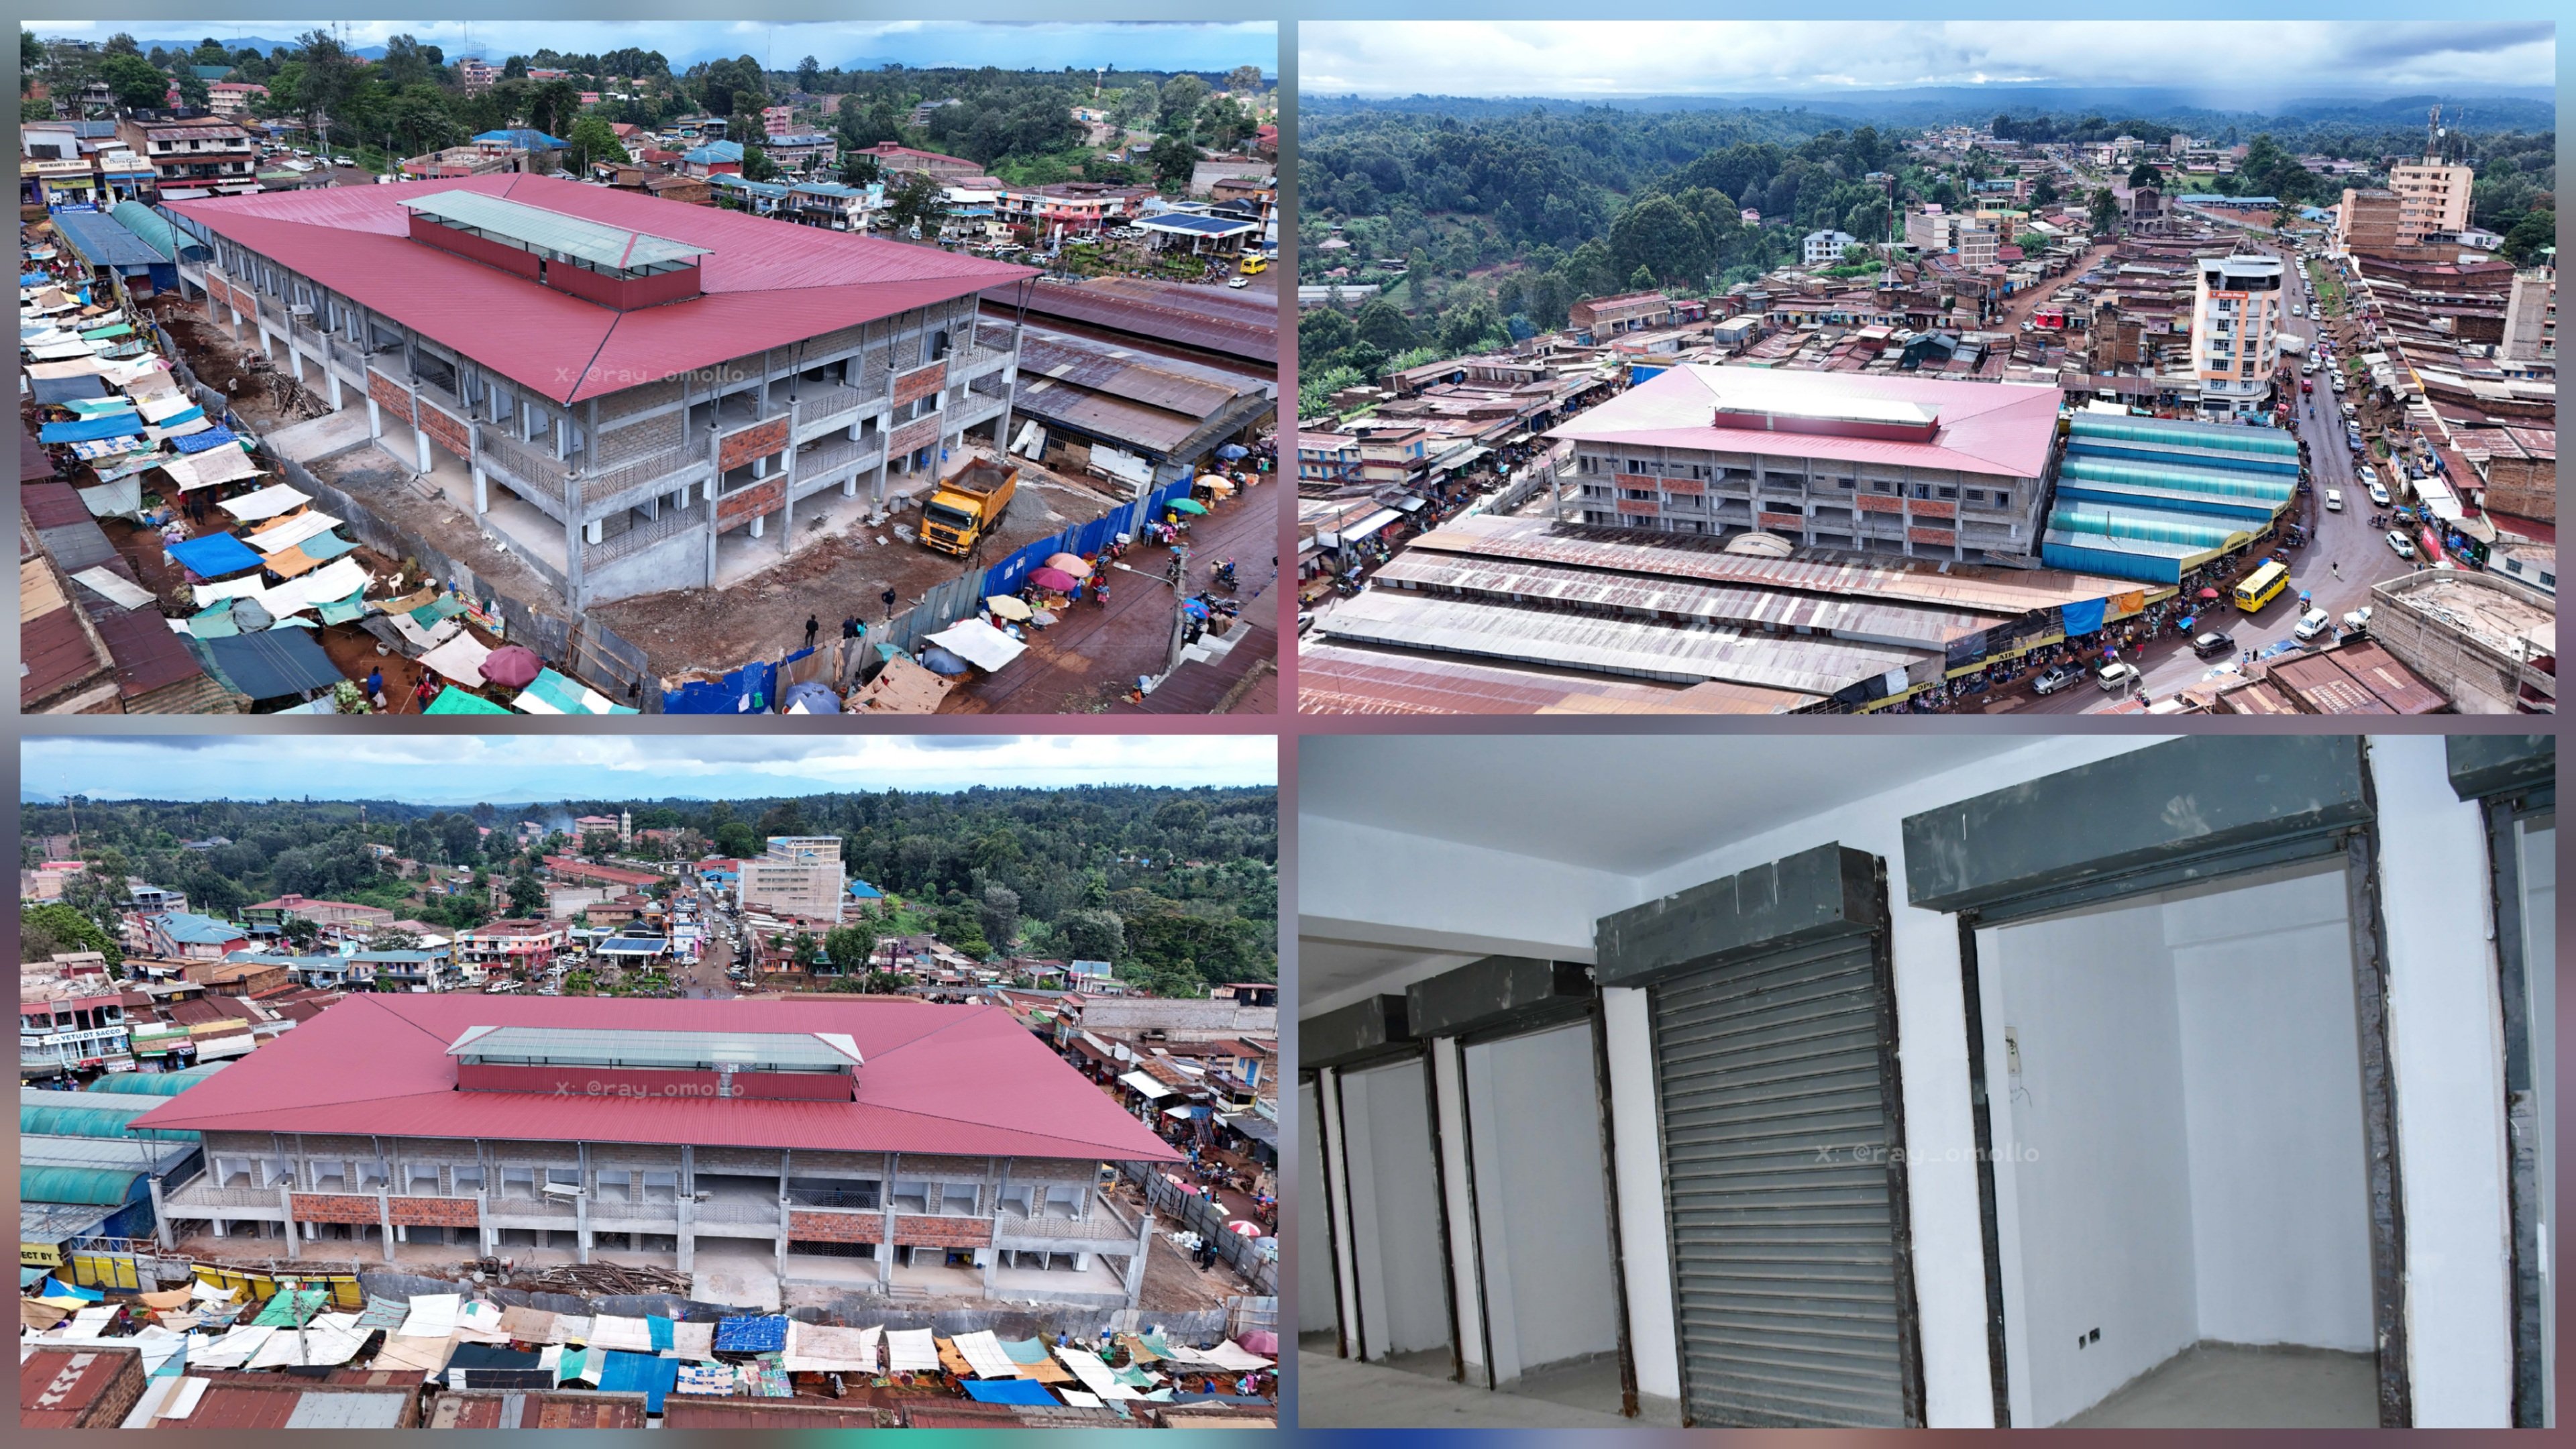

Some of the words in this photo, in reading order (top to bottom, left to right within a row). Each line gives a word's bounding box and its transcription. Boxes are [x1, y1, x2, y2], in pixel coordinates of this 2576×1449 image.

[1998, 651, 2015, 660] AIR
[1917, 682, 1936, 691] OPE
[96, 1028, 121, 1036] SACCO
[21, 1251, 38, 1259] ECT
[40, 1252, 52, 1260] BY
